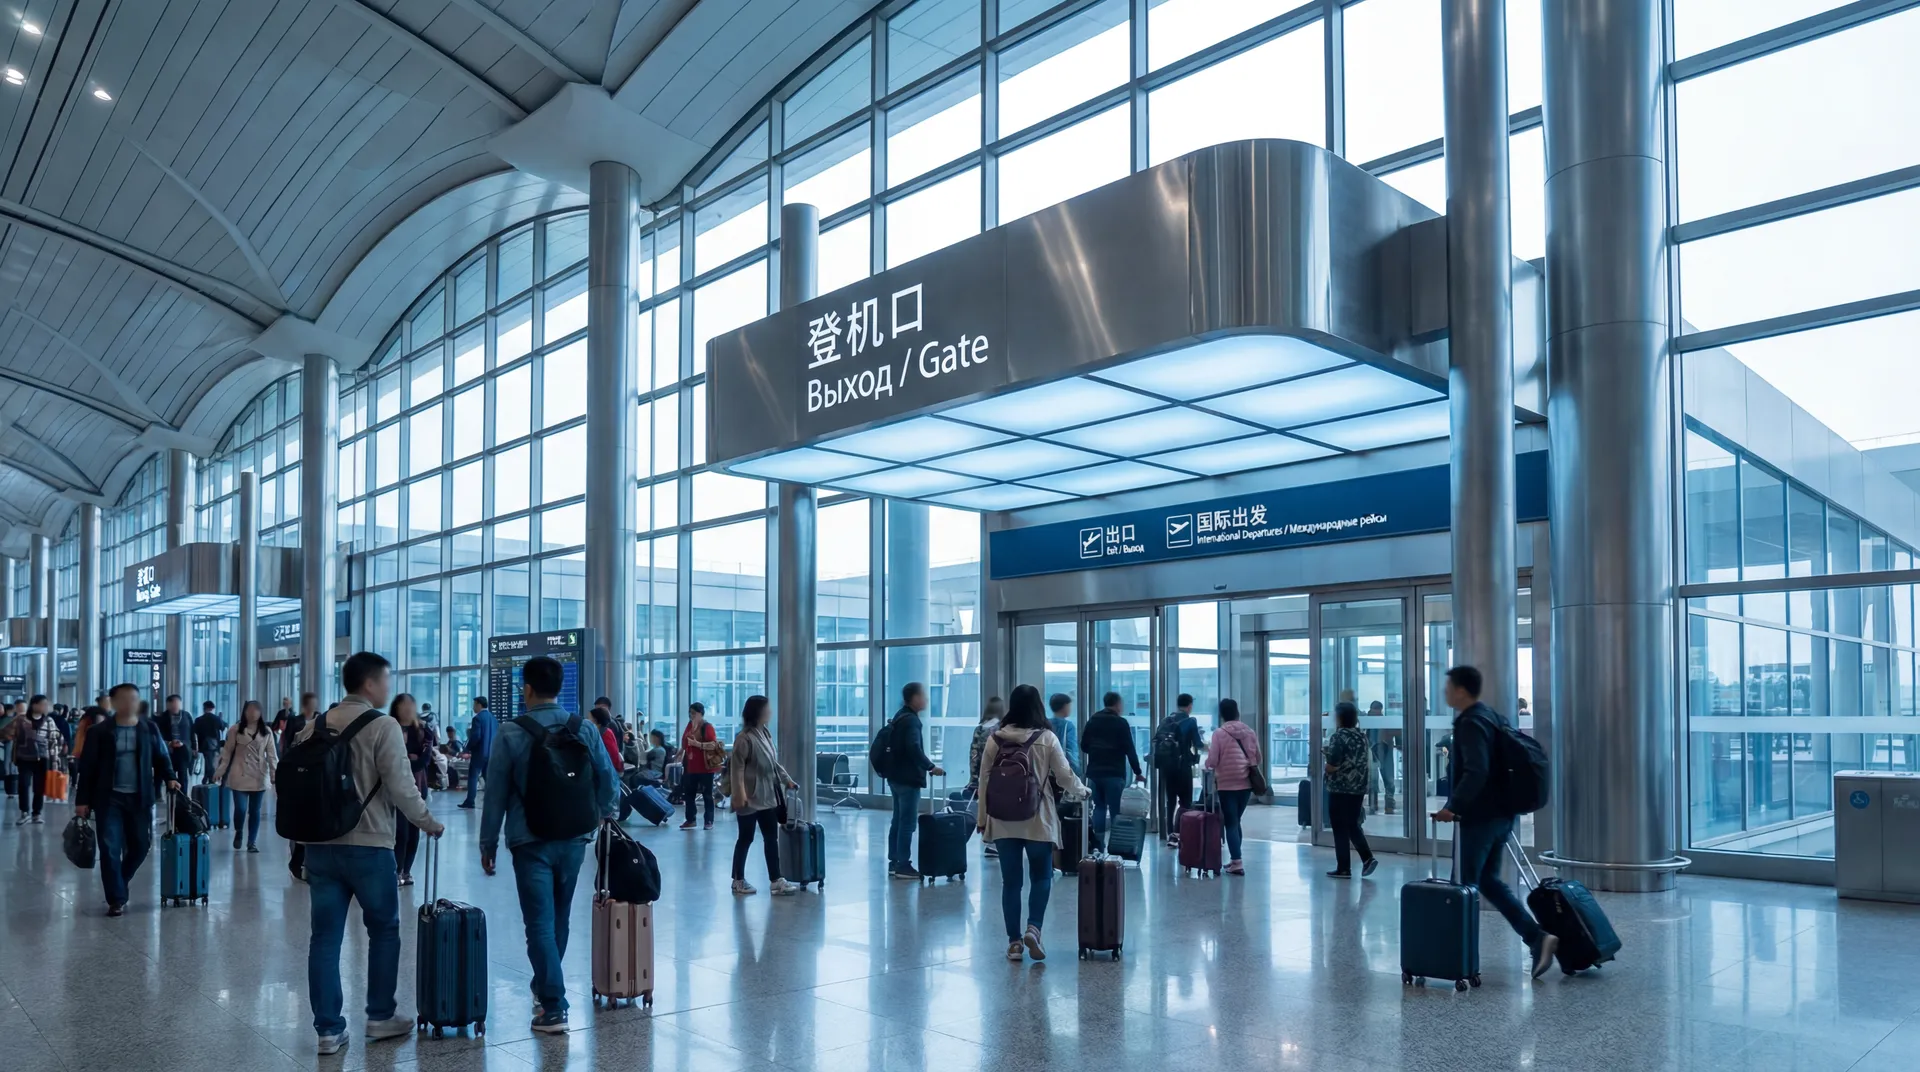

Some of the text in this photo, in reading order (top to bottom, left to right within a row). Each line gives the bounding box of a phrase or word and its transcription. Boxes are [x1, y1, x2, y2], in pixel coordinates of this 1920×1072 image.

[807, 282, 924, 370] 登机口
[807, 333, 989, 413] Выход / Gate
[1106, 524, 1135, 544] 出口
[1197, 504, 1268, 533] 国际出发
